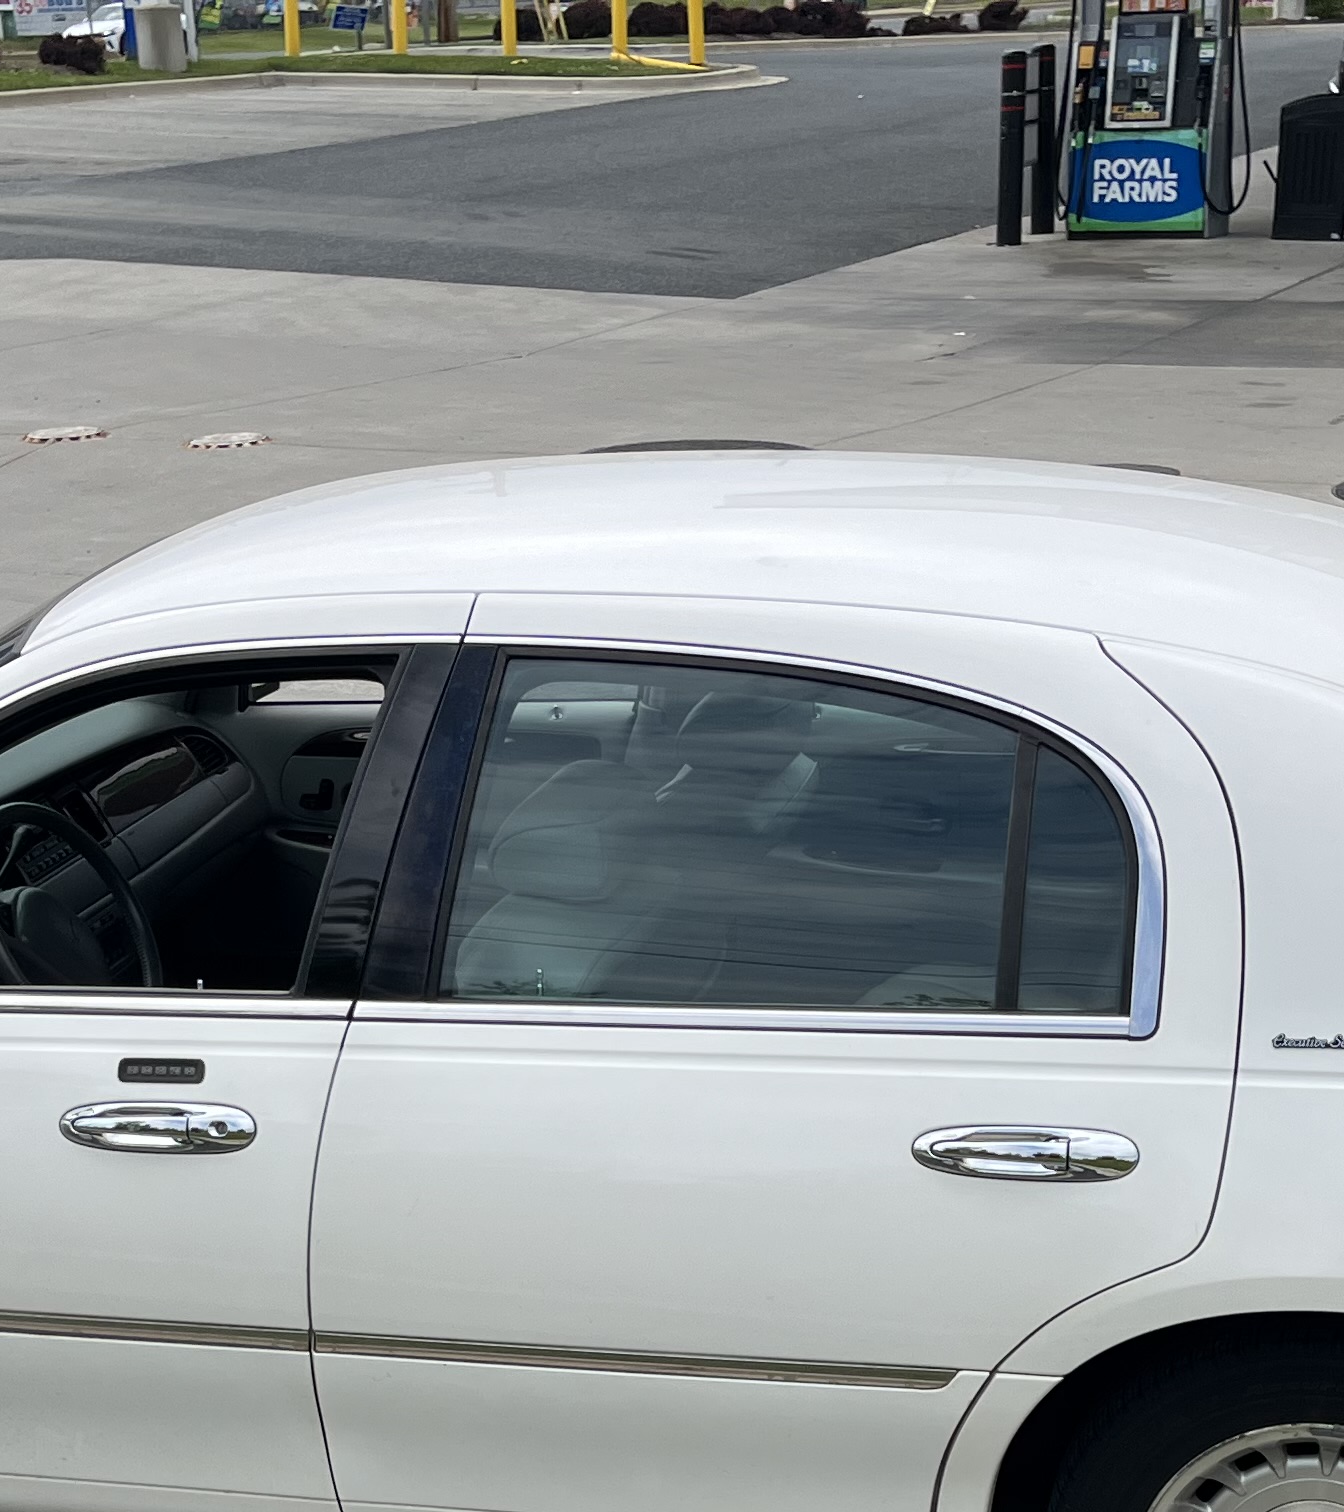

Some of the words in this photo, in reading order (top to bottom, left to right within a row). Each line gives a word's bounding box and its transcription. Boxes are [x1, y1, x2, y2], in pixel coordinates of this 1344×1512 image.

[1093, 157, 1179, 180] ROYAL
[1092, 180, 1178, 203] FARMS
[1272, 1033, 1328, 1049] Executive
